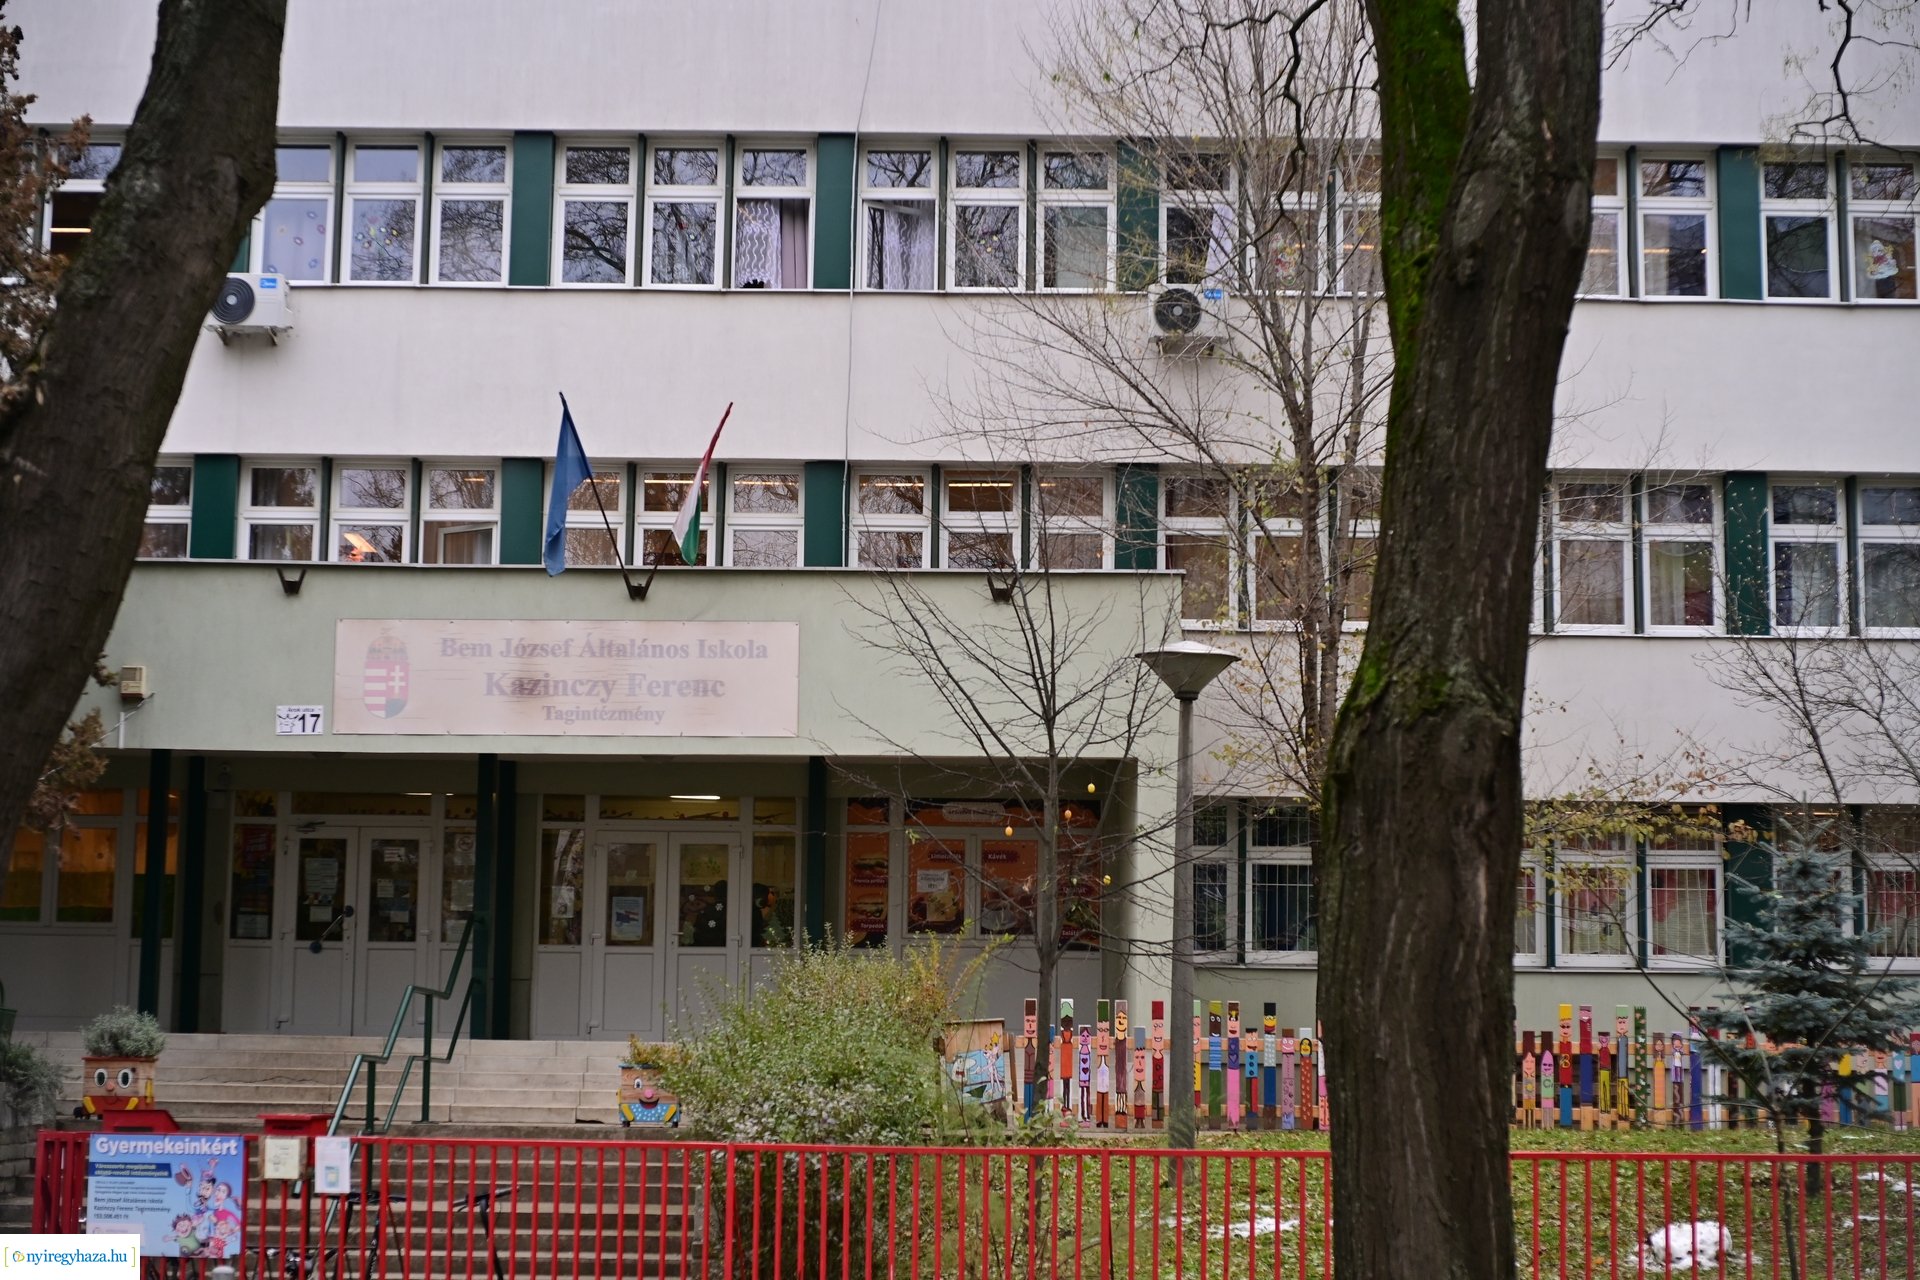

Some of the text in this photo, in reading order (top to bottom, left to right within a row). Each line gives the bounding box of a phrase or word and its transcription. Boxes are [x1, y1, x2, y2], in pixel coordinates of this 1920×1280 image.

[439, 631, 769, 660] Bem József Általános Iskola
[483, 672, 726, 703] Kazinczy Ferenc
[298, 713, 321, 733] 17
[542, 705, 666, 725] Tagintézmény
[95, 1137, 238, 1157] Gyermekeinkért
